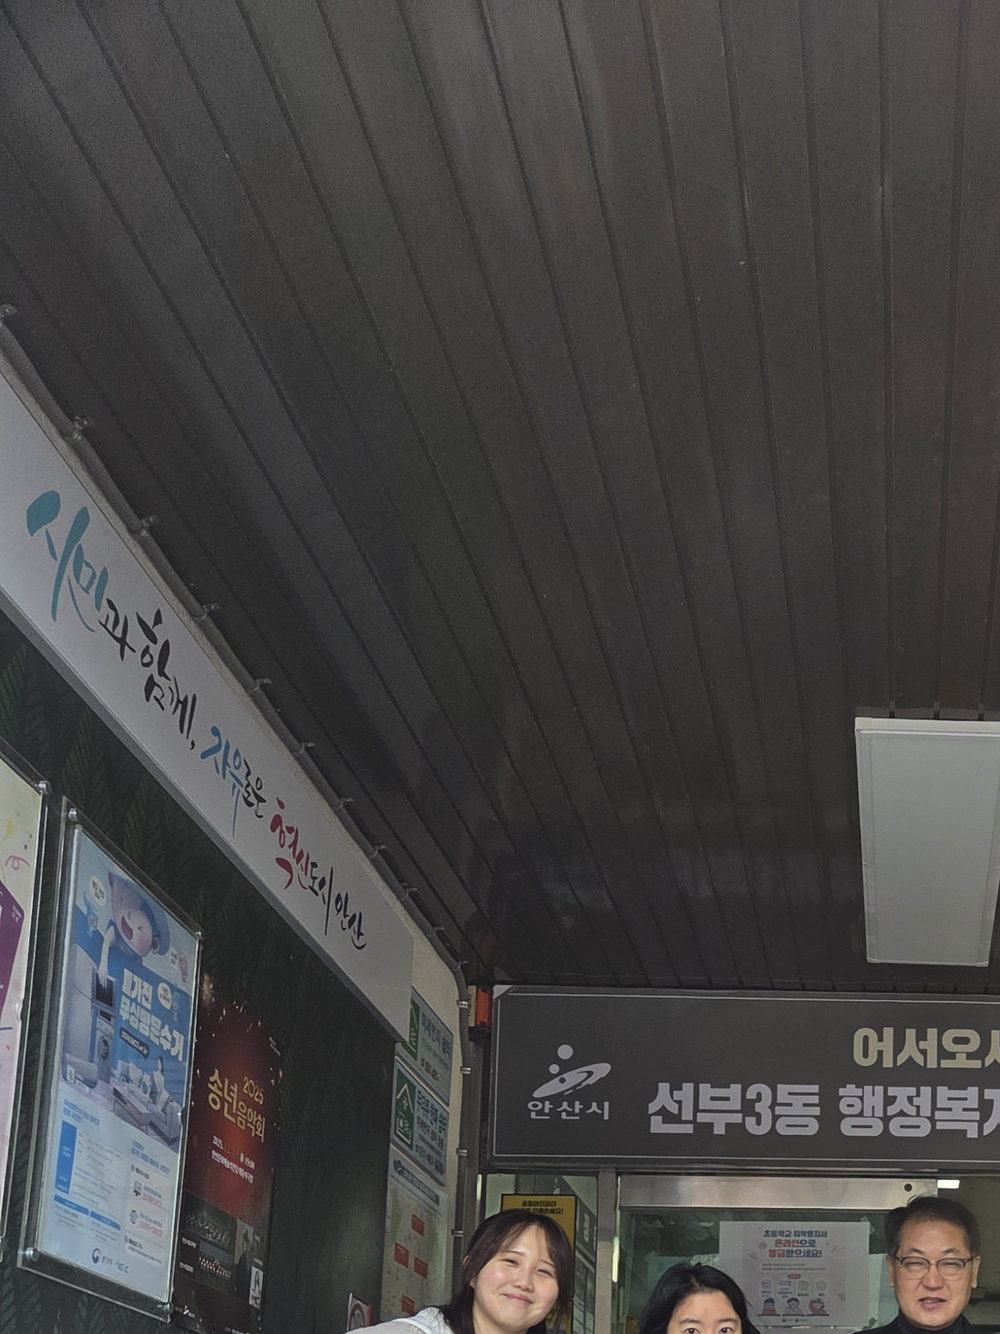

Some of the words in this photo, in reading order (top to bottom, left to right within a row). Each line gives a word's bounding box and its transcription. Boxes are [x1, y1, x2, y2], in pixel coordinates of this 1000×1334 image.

[243, 1076, 264, 1105] 2025
[208, 1068, 265, 1143] 송년음악회
[527, 1100, 610, 1121] 안산시
[648, 1082, 821, 1136] 선부3동
[774, 1239, 817, 1248] 온라인으로
